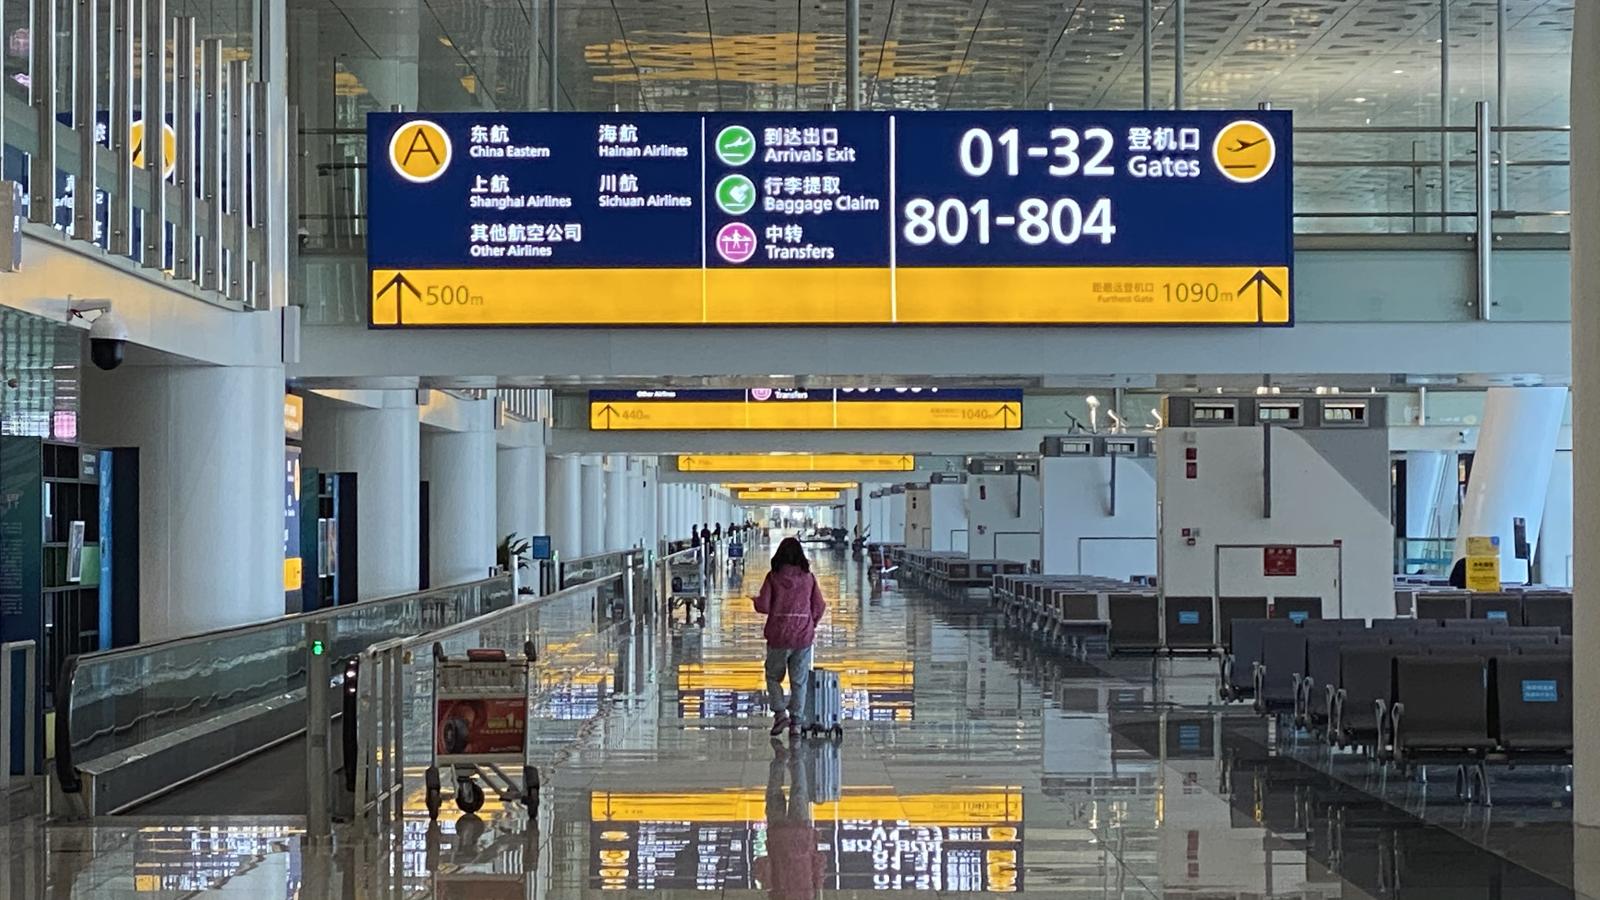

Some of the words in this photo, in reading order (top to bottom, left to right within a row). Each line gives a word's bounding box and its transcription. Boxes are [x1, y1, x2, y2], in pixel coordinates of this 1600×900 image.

[470, 125, 509, 144] 东航
[598, 124, 638, 144] 海航
[764, 127, 839, 147] 到达出口
[1127, 127, 1200, 152] 登机口
[403, 127, 441, 166] A
[469, 145, 505, 158] China
[506, 145, 551, 158] Eastern
[598, 145, 641, 158] Hainan
[643, 144, 689, 157] Airlines
[764, 147, 824, 163] Arrivals
[826, 147, 856, 163] Exit
[959, 127, 1115, 177] 01-32
[1127, 154, 1201, 178] Gates
[470, 174, 510, 193] 上航
[599, 174, 639, 193] 川航
[764, 176, 841, 195] 行李提取
[469, 195, 525, 210] Shanghai
[526, 195, 572, 208] Airlines
[598, 195, 645, 208] Sichuan
[646, 194, 692, 207] Airlines
[764, 196, 833, 215] Baggage
[835, 195, 880, 212] Claim
[904, 198, 1117, 246] 801-804
[470, 224, 582, 243] 其他航空公司
[765, 224, 804, 244] 中转
[469, 244, 506, 257] Other
[507, 244, 553, 257] Airlines
[764, 244, 835, 260] Transfers
[426, 285, 484, 306] 500m
[1163, 282, 1233, 303] 1090m
[775, 391, 809, 399] Transfers
